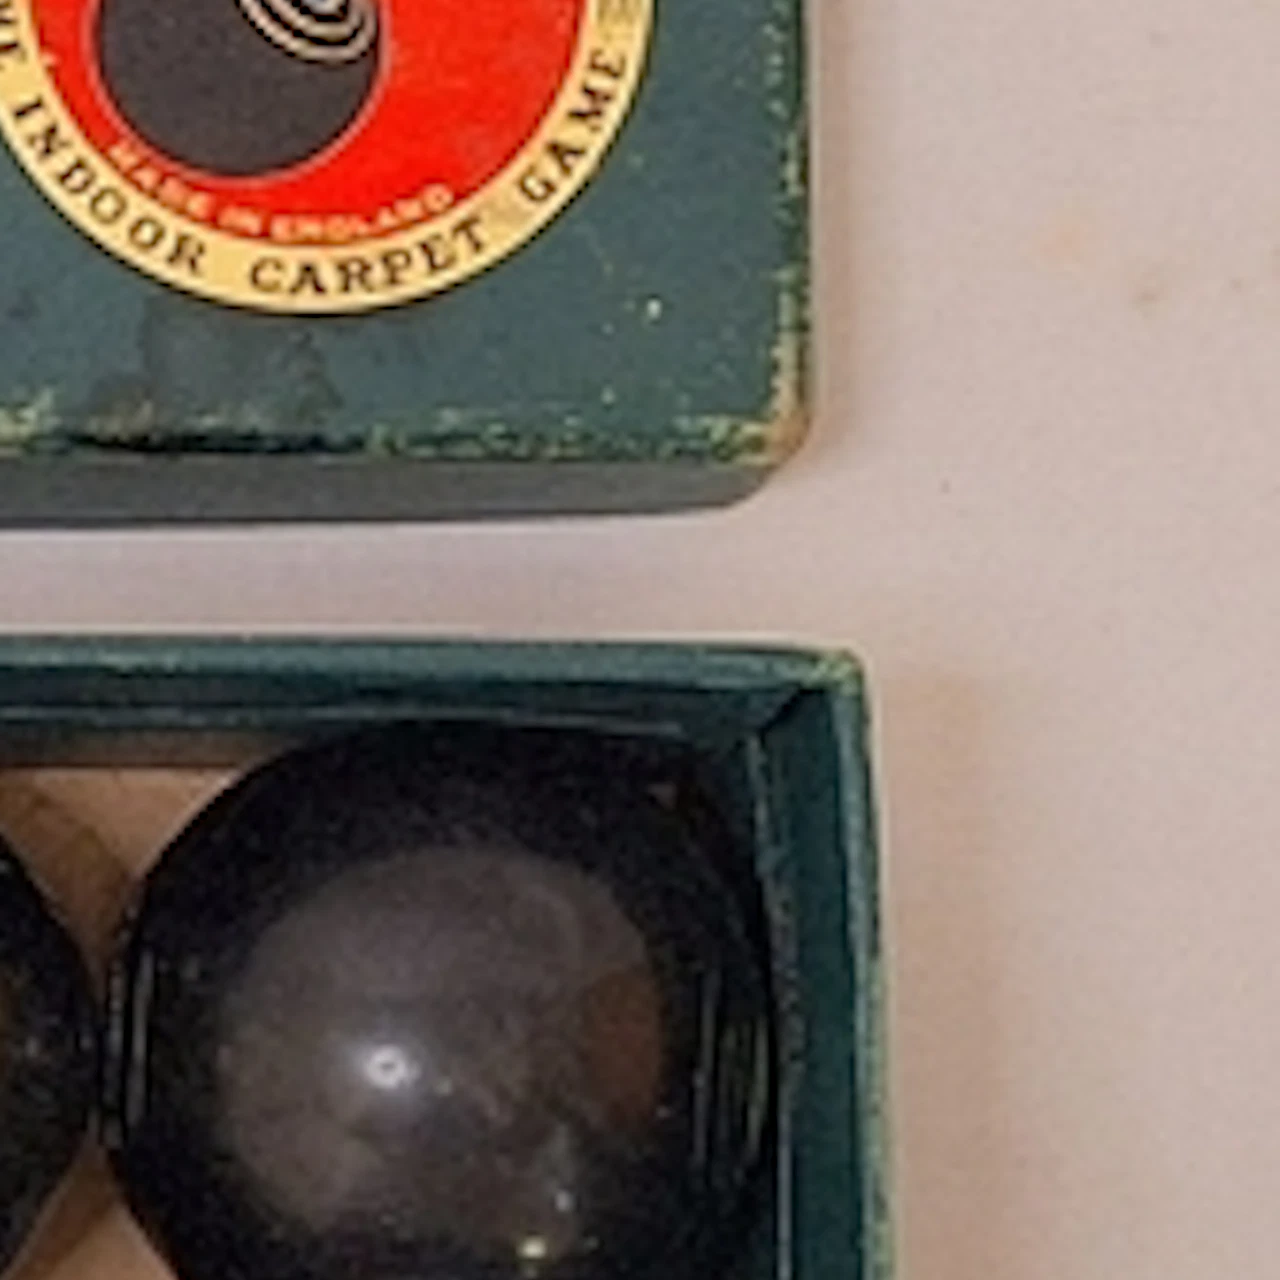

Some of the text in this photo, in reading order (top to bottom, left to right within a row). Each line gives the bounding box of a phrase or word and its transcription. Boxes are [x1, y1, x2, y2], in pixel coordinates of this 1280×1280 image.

[12, 92, 208, 275] INDOOR
[248, 218, 488, 295] CARPET
[517, 47, 627, 205] GAME
